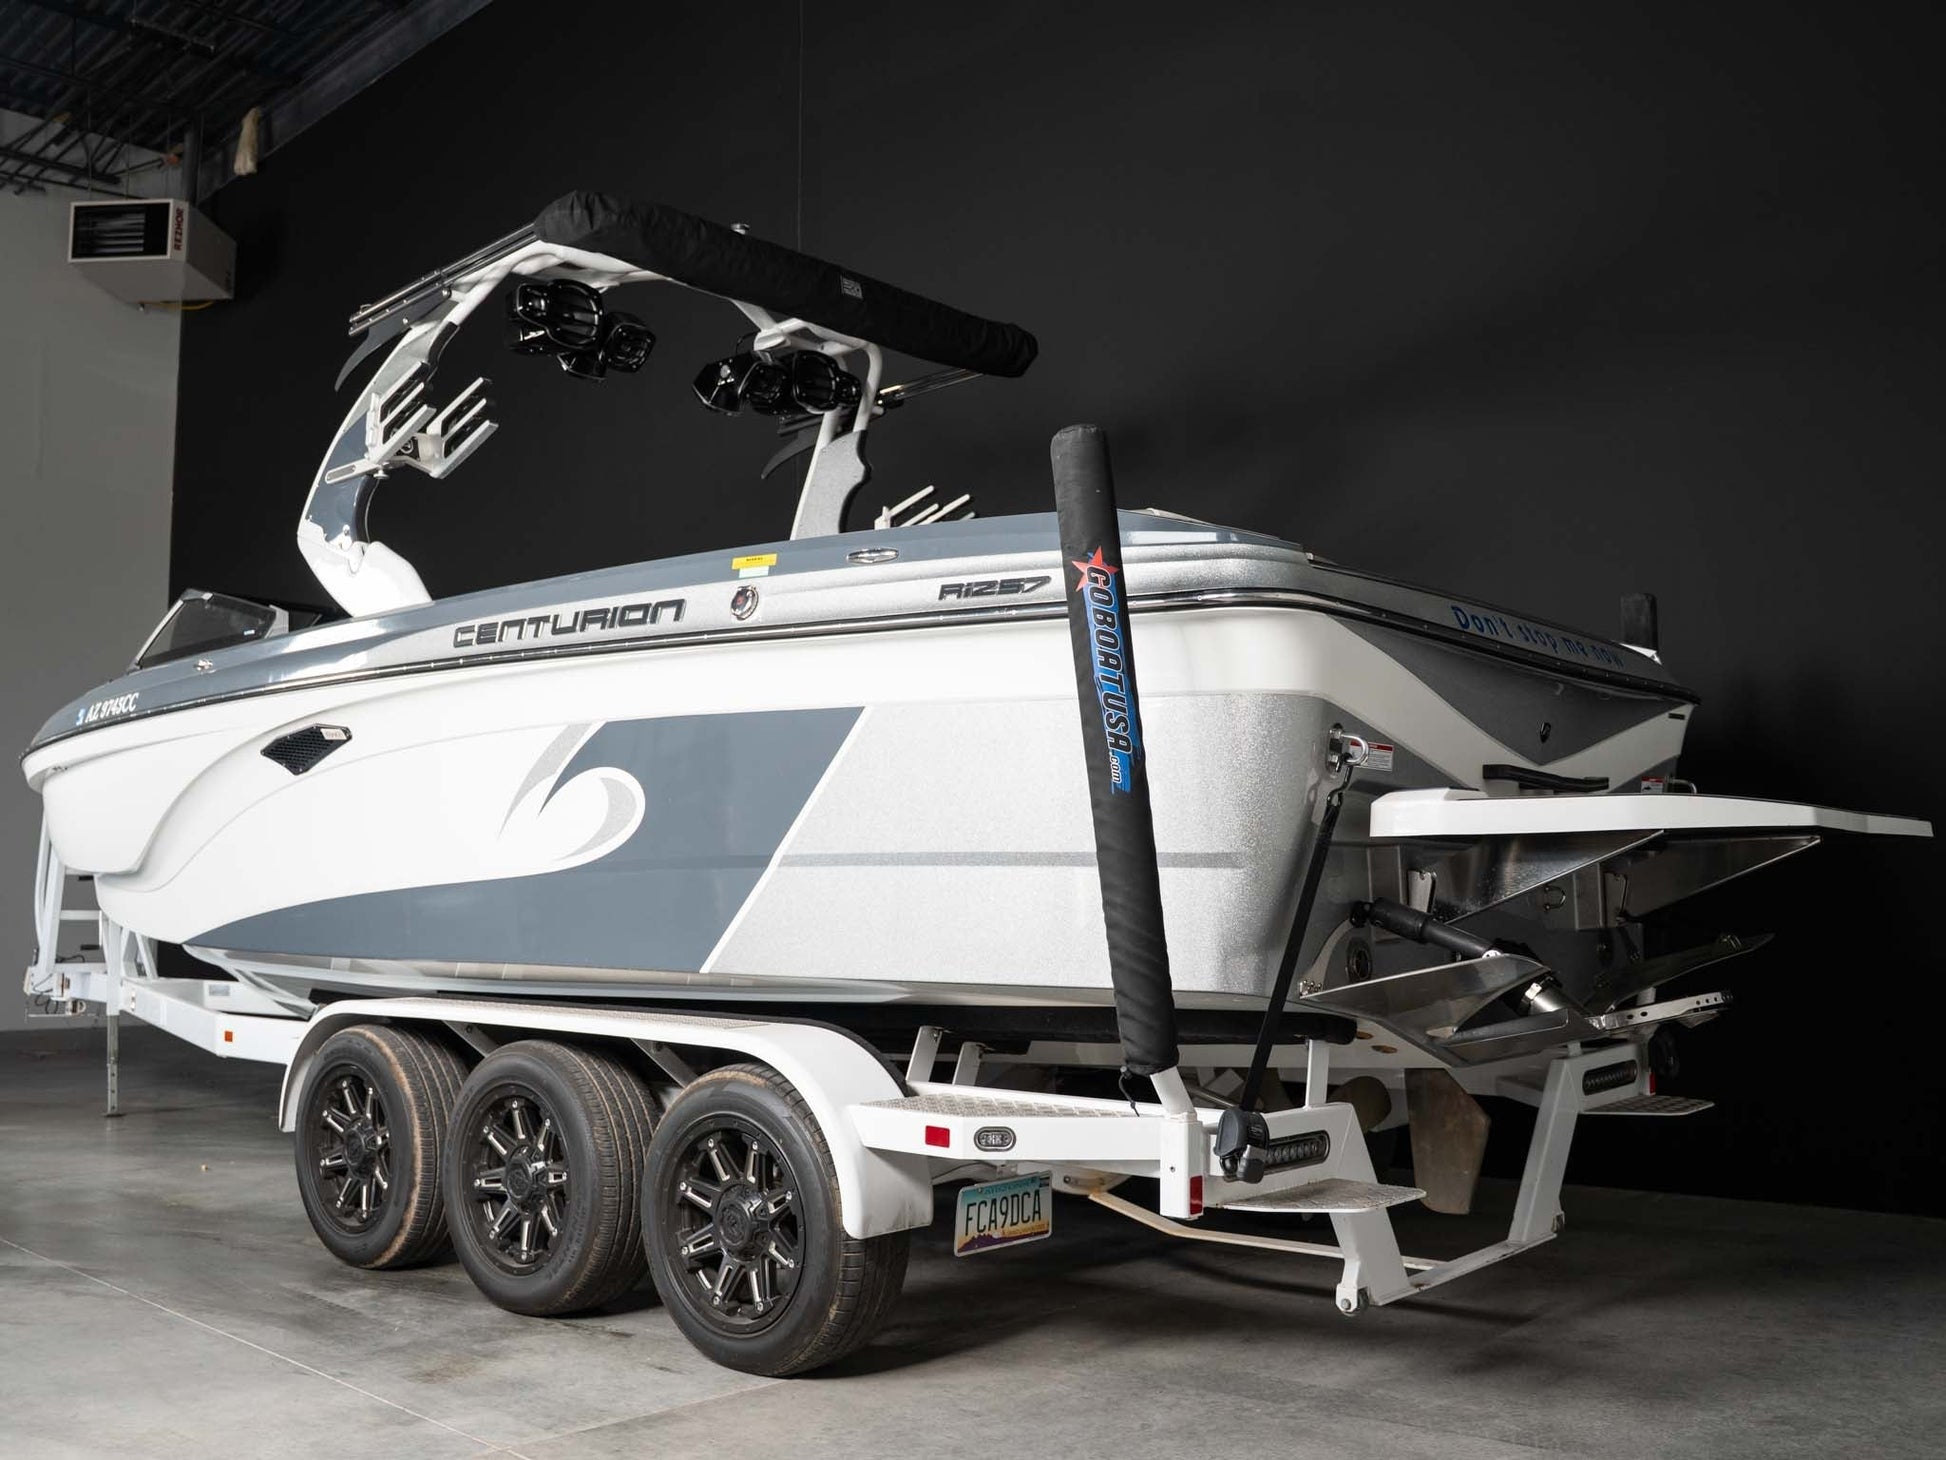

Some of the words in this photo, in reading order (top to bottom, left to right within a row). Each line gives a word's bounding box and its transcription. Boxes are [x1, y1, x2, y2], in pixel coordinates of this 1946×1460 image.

[453, 598, 686, 648] CENTURION
[1451, 605, 1513, 638] Don't
[1518, 624, 1558, 654] stop
[1561, 636, 1588, 658] me
[965, 1189, 1042, 1236] FCA9DCA
